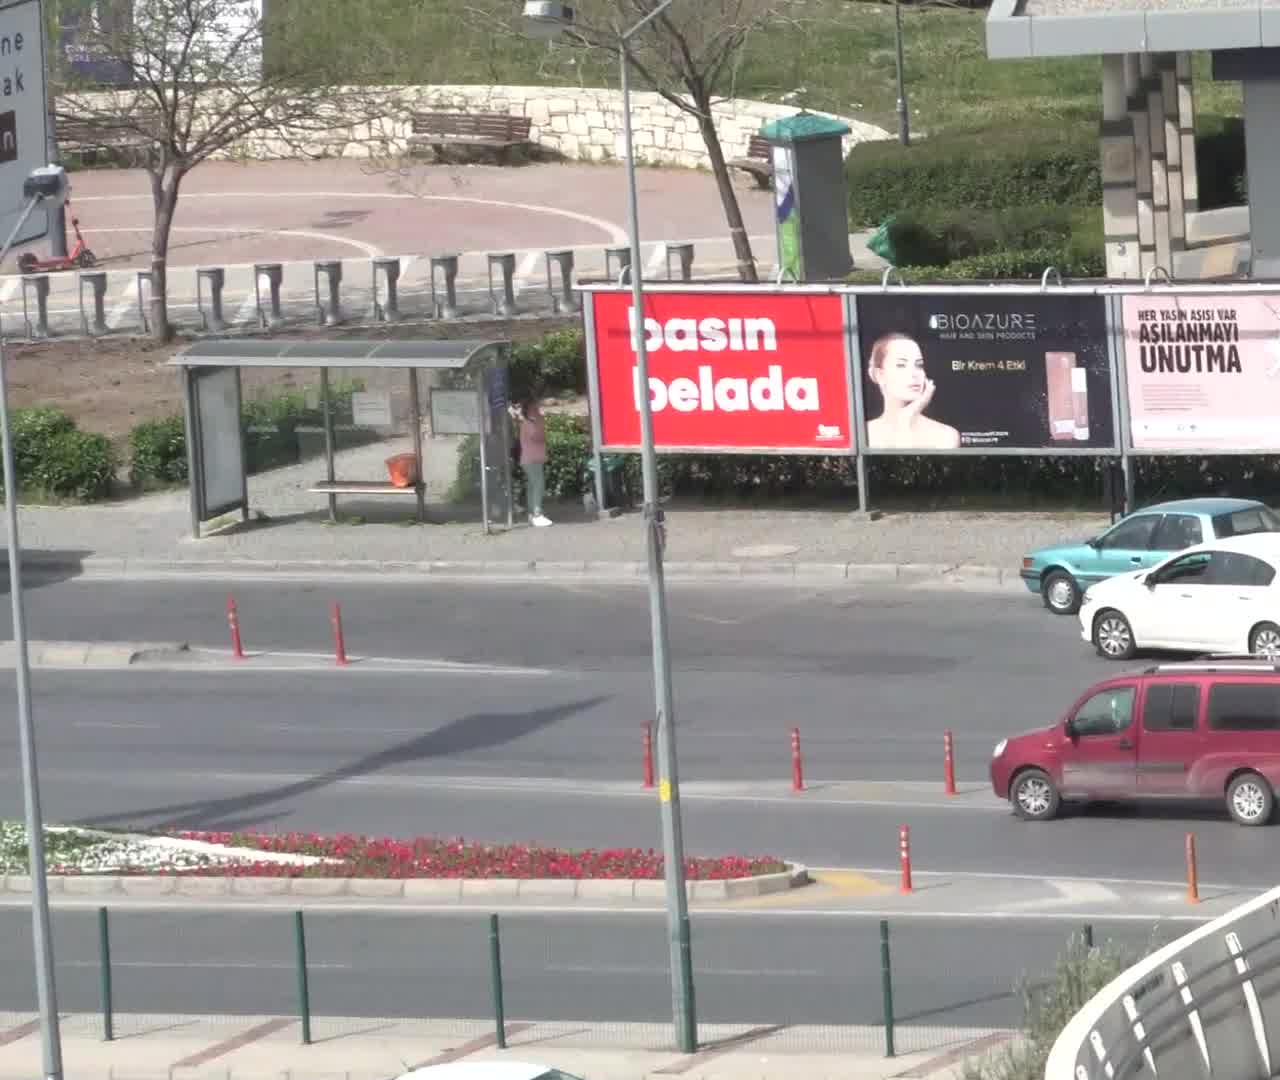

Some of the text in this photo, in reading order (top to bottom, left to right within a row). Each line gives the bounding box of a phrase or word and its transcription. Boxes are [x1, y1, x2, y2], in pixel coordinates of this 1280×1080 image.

[937, 313, 1037, 330] BIOAZURE
[1138, 309, 1157, 321] HER
[1217, 309, 1237, 321] VAR
[951, 360, 966, 371] Bir
[968, 360, 996, 371] Krem
[1140, 345, 1242, 374] UNUTMA
[632, 365, 820, 412] belada
